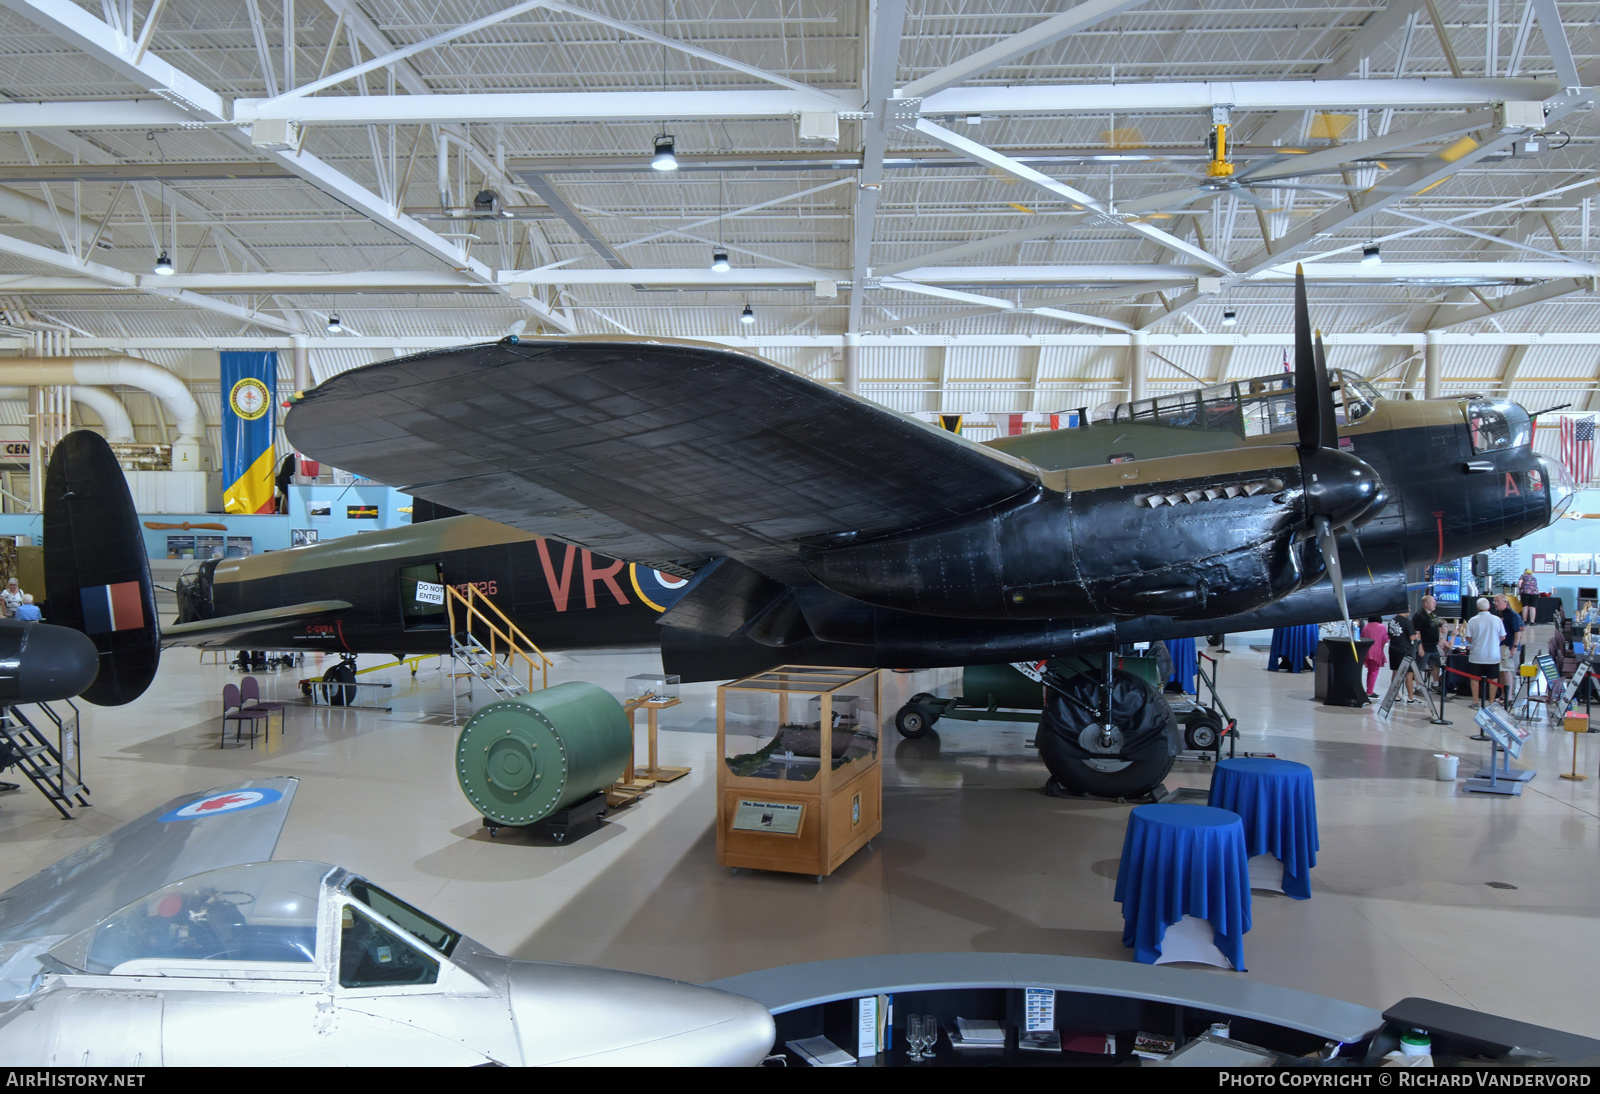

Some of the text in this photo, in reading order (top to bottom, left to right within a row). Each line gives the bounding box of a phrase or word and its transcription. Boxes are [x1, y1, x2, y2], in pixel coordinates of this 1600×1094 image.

[1505, 472, 1520, 497] A
[535, 538, 631, 612] VR
[418, 583, 444, 593] DO NOT
[419, 592, 441, 601] ENTER
